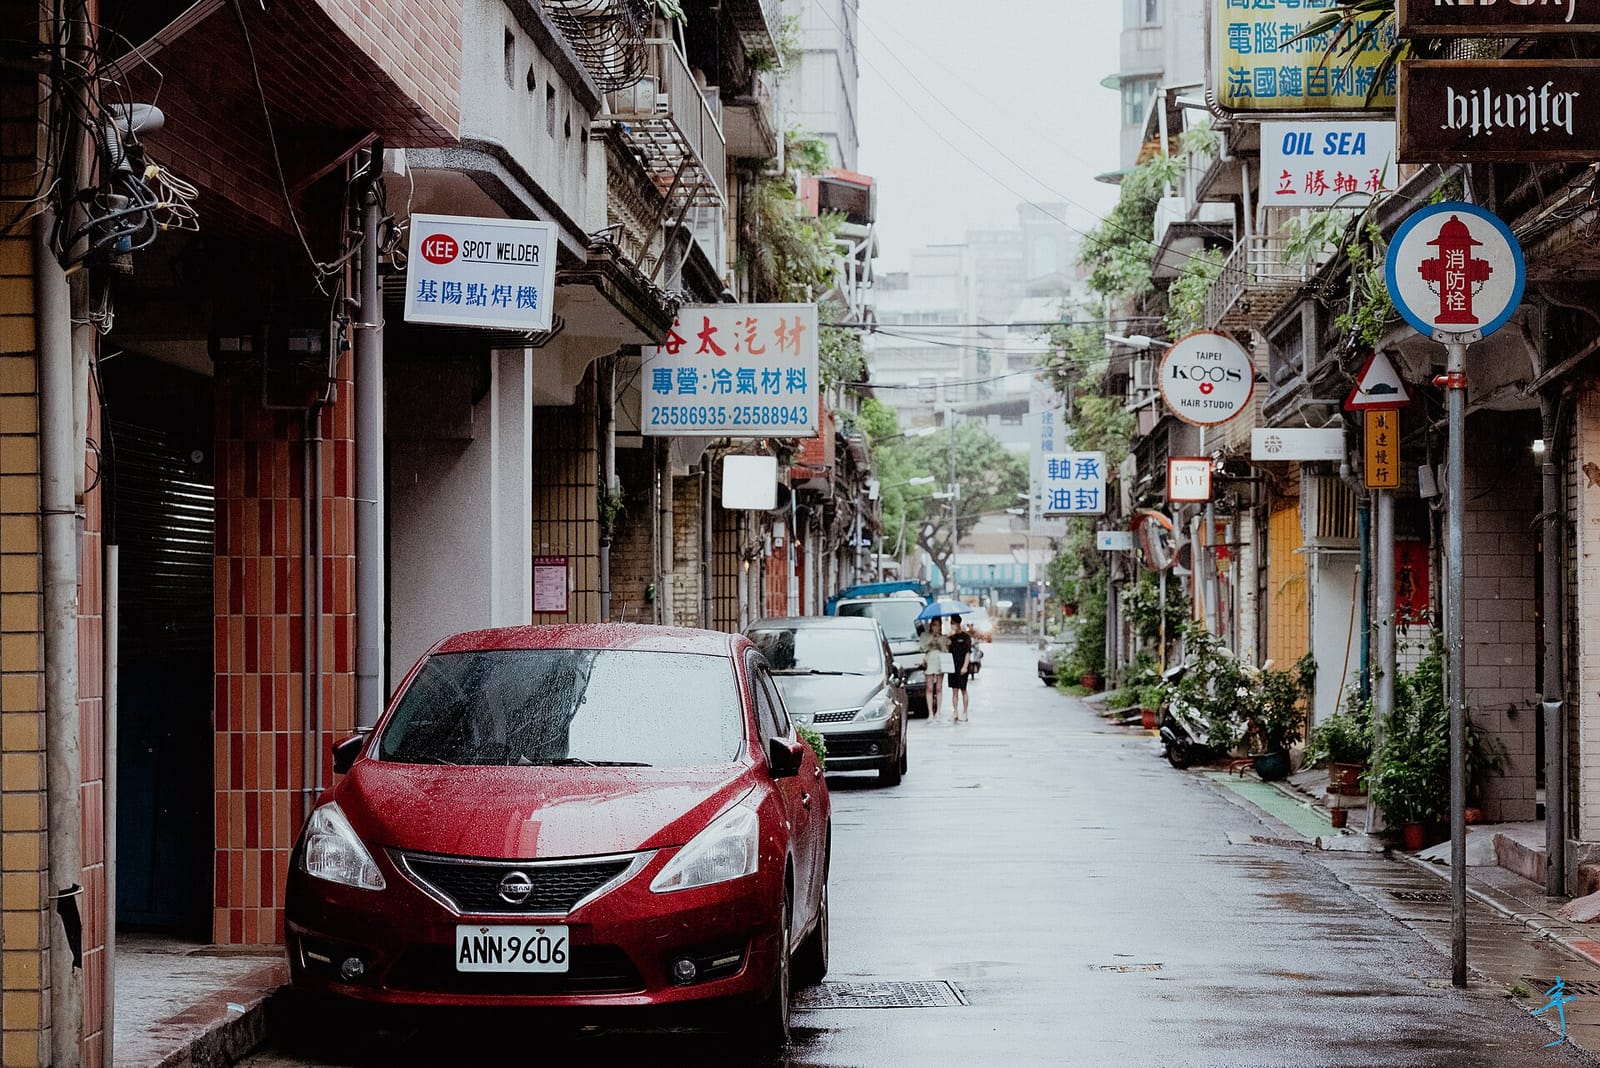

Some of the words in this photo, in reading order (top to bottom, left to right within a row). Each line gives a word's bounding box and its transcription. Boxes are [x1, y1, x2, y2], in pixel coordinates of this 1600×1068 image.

[1282, 131, 1315, 156] OIL
[1322, 131, 1366, 156] SEA
[1275, 168, 1388, 197] 立勝軸承
[425, 240, 454, 259] KEE
[462, 240, 491, 259] SPOT
[497, 242, 540, 263] WELDER
[1445, 249, 1467, 311] 消防栓
[416, 279, 538, 310] 基陽點焊機
[1196, 351, 1222, 361] TAIPEI
[1172, 365, 1242, 383] KOOS
[1180, 399, 1201, 408] HAIR
[1203, 399, 1234, 410] STUDIO
[1048, 457, 1100, 481] 軸承
[1048, 487, 1100, 510] 油封
